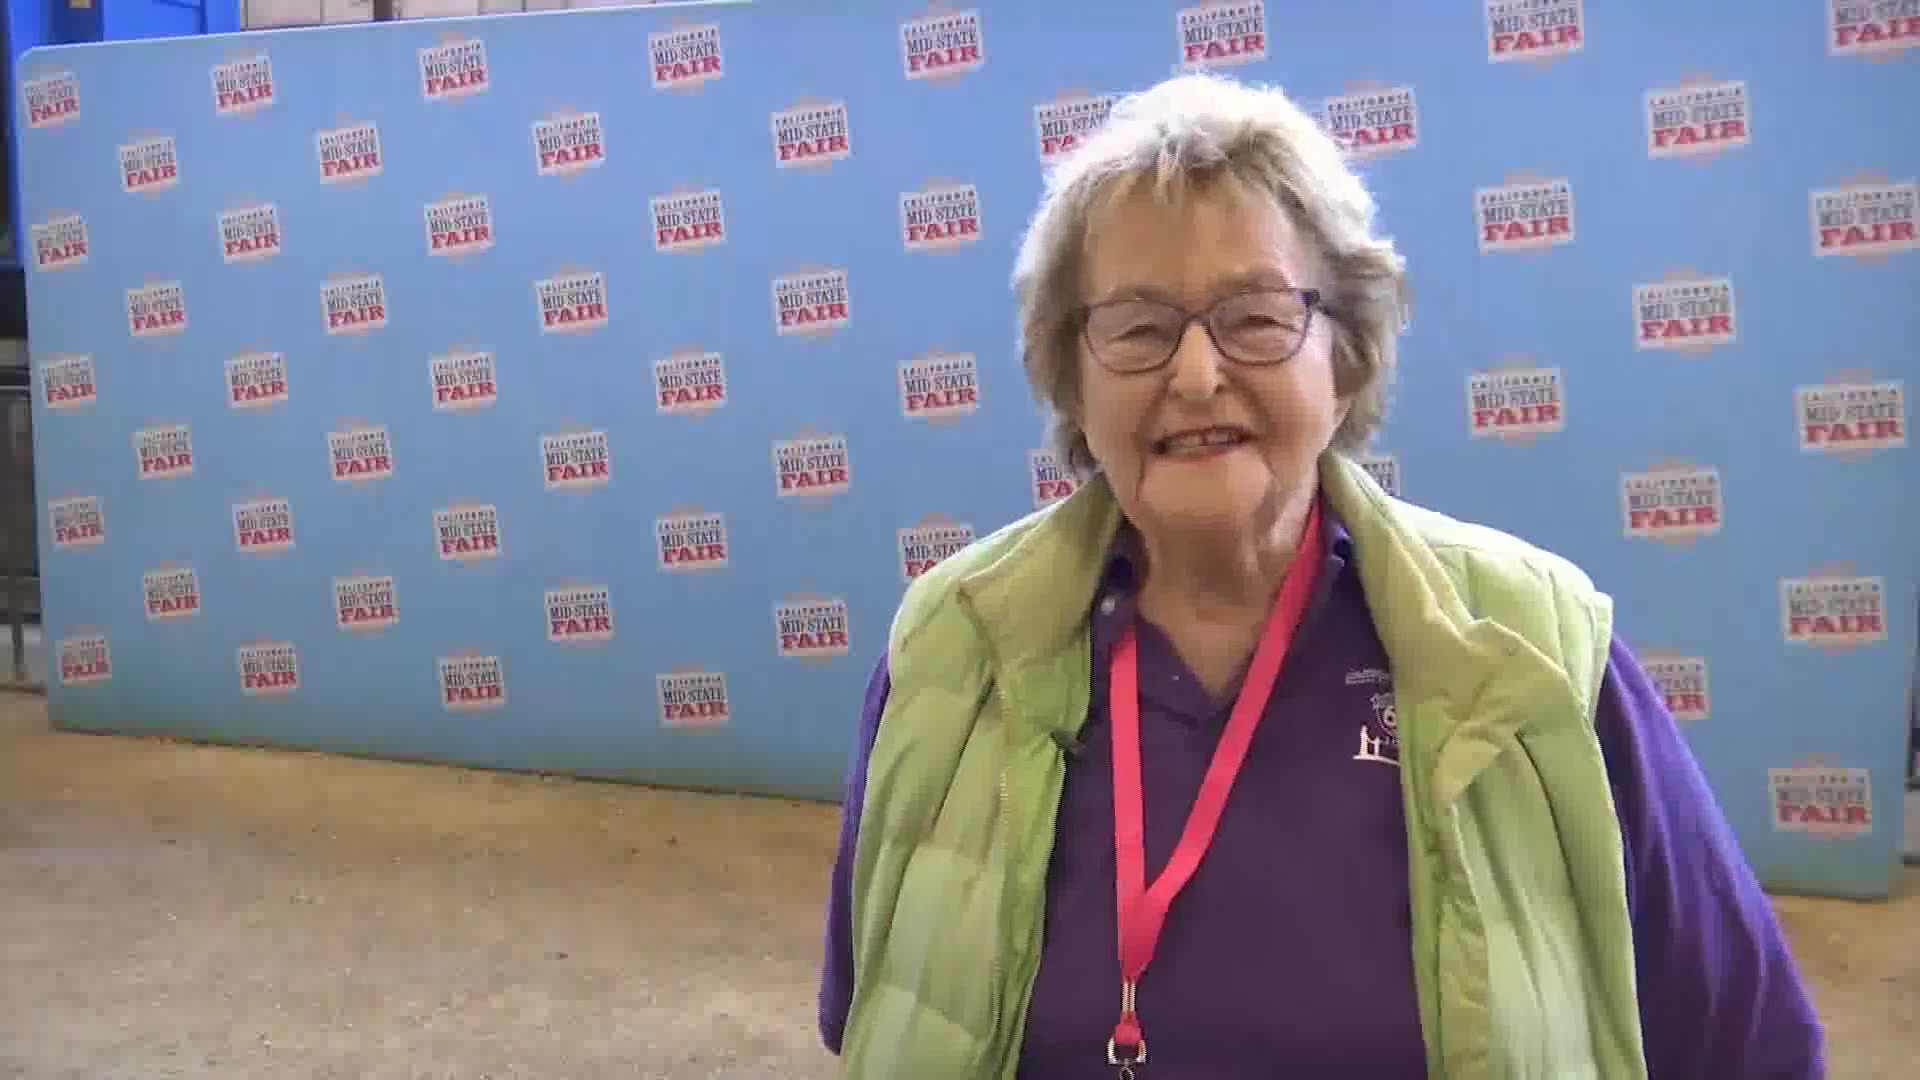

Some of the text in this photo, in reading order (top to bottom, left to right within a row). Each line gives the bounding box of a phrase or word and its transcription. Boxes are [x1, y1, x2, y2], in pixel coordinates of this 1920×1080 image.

[1185, 33, 1264, 60] FAIR
[1494, 24, 1583, 52] FAIR
[908, 44, 980, 70] FAIR
[655, 55, 721, 81] FAIR
[426, 68, 486, 93] FAIR
[218, 83, 273, 107] FAIR
[540, 143, 602, 166] FAIR
[779, 135, 847, 159] FAIR
[1042, 135, 1073, 154] FA
[323, 152, 379, 175] FAIR
[431, 225, 490, 248] FAIR
[658, 221, 722, 244] FAIR
[908, 217, 979, 241] FAIR
[1484, 216, 1571, 241] FAIR
[225, 232, 279, 254] FAIR
[329, 305, 385, 326] FAIR
[543, 303, 605, 324] FAIR
[780, 302, 847, 325] FAIR
[232, 380, 286, 400] FAIR
[436, 381, 495, 401] FAIR
[660, 384, 724, 404] FAIR
[907, 388, 977, 409] FAIR
[1475, 404, 1560, 426] FAIR
[335, 455, 390, 475] FAIR
[547, 461, 608, 480] FAIR
[781, 468, 847, 488] FAIR
[1037, 479, 1073, 499] FA
[239, 527, 292, 545] FAIR
[441, 534, 499, 552] FAIR
[662, 544, 725, 562] FAIR
[905, 560, 936, 577] FA
[340, 604, 395, 621] FAIR
[551, 616, 611, 634] FAIR
[781, 631, 847, 648] FAIR
[244, 671, 297, 687] FAIR
[445, 685, 502, 700] FAIR
[664, 701, 727, 718] FAIR
